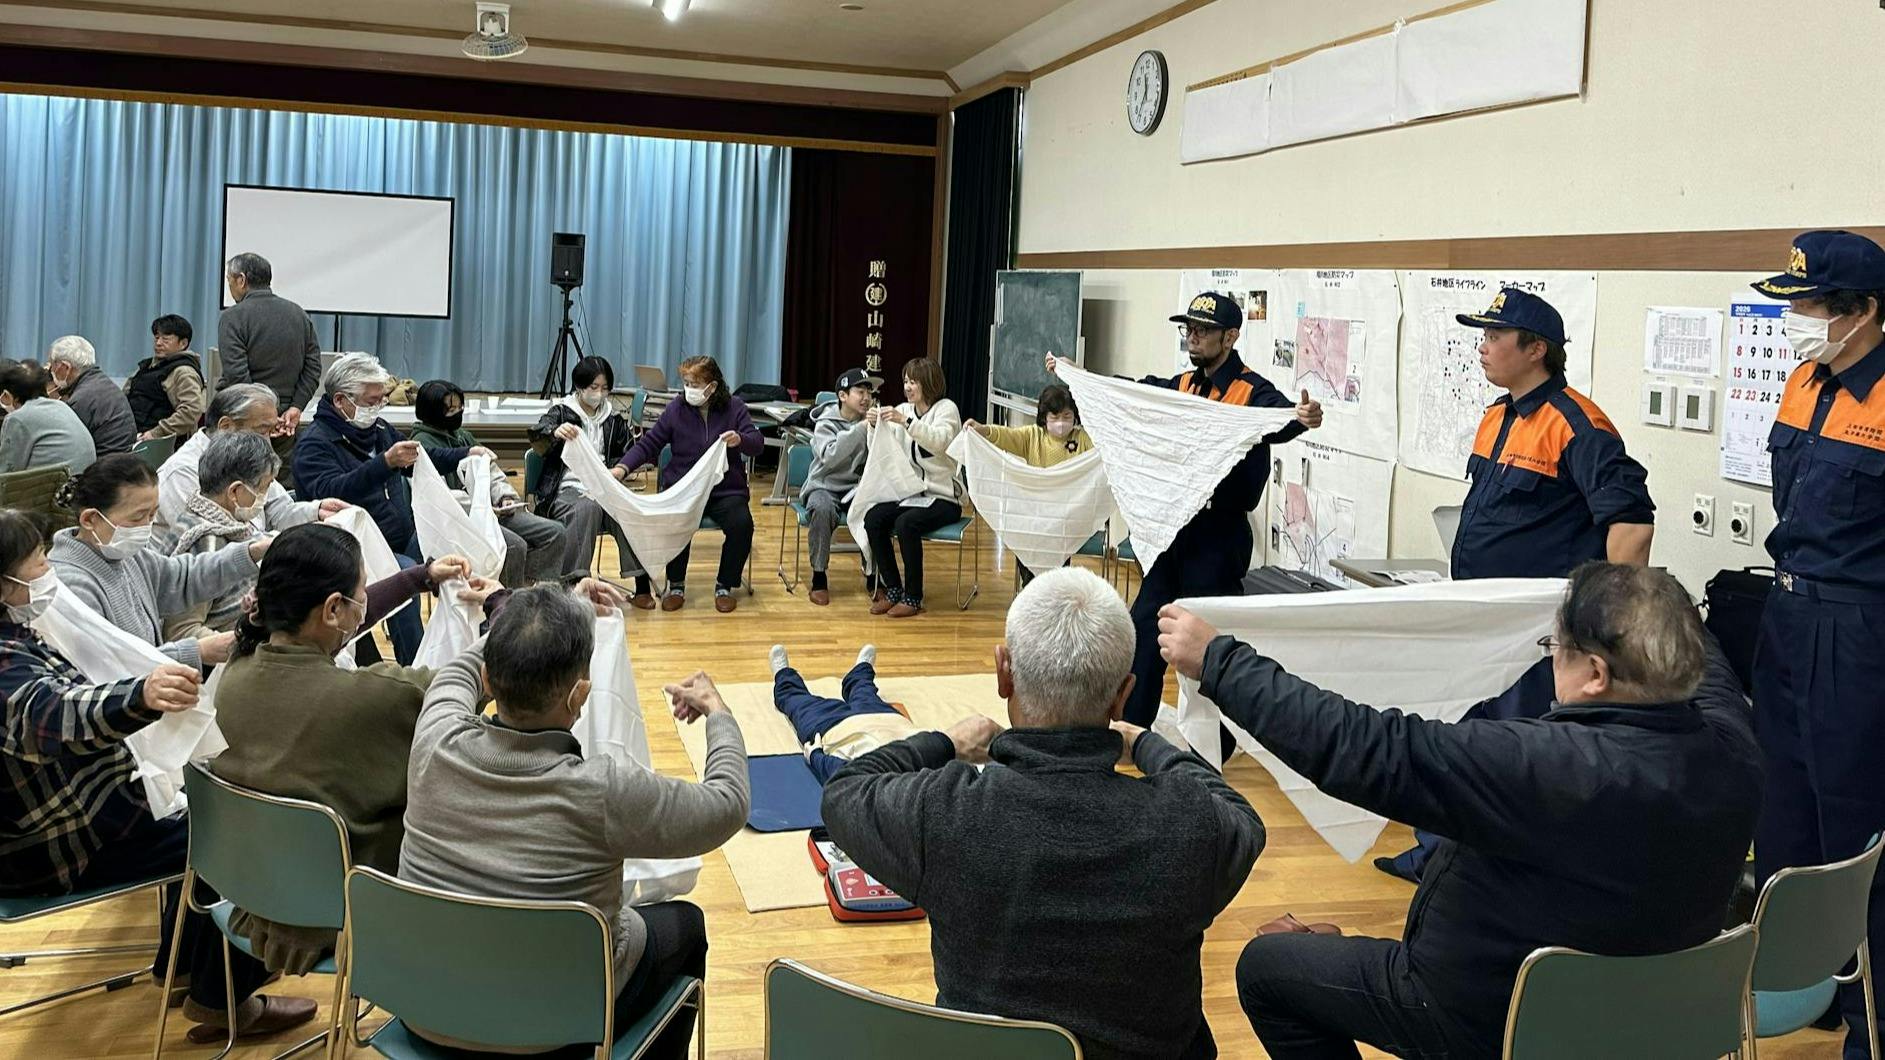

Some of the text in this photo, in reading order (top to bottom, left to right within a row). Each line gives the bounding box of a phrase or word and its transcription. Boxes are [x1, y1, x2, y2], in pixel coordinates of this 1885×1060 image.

[1739, 324, 1787, 337] 1 2 3 4
[1736, 345, 1743, 356] 8
[1750, 346, 1757, 357] 9
[1763, 347, 1773, 358] 10
[1779, 348, 1787, 360] 11
[1733, 367, 1787, 382] 15 16 17 18
[1730, 388, 1781, 404] 22 23 24 2
